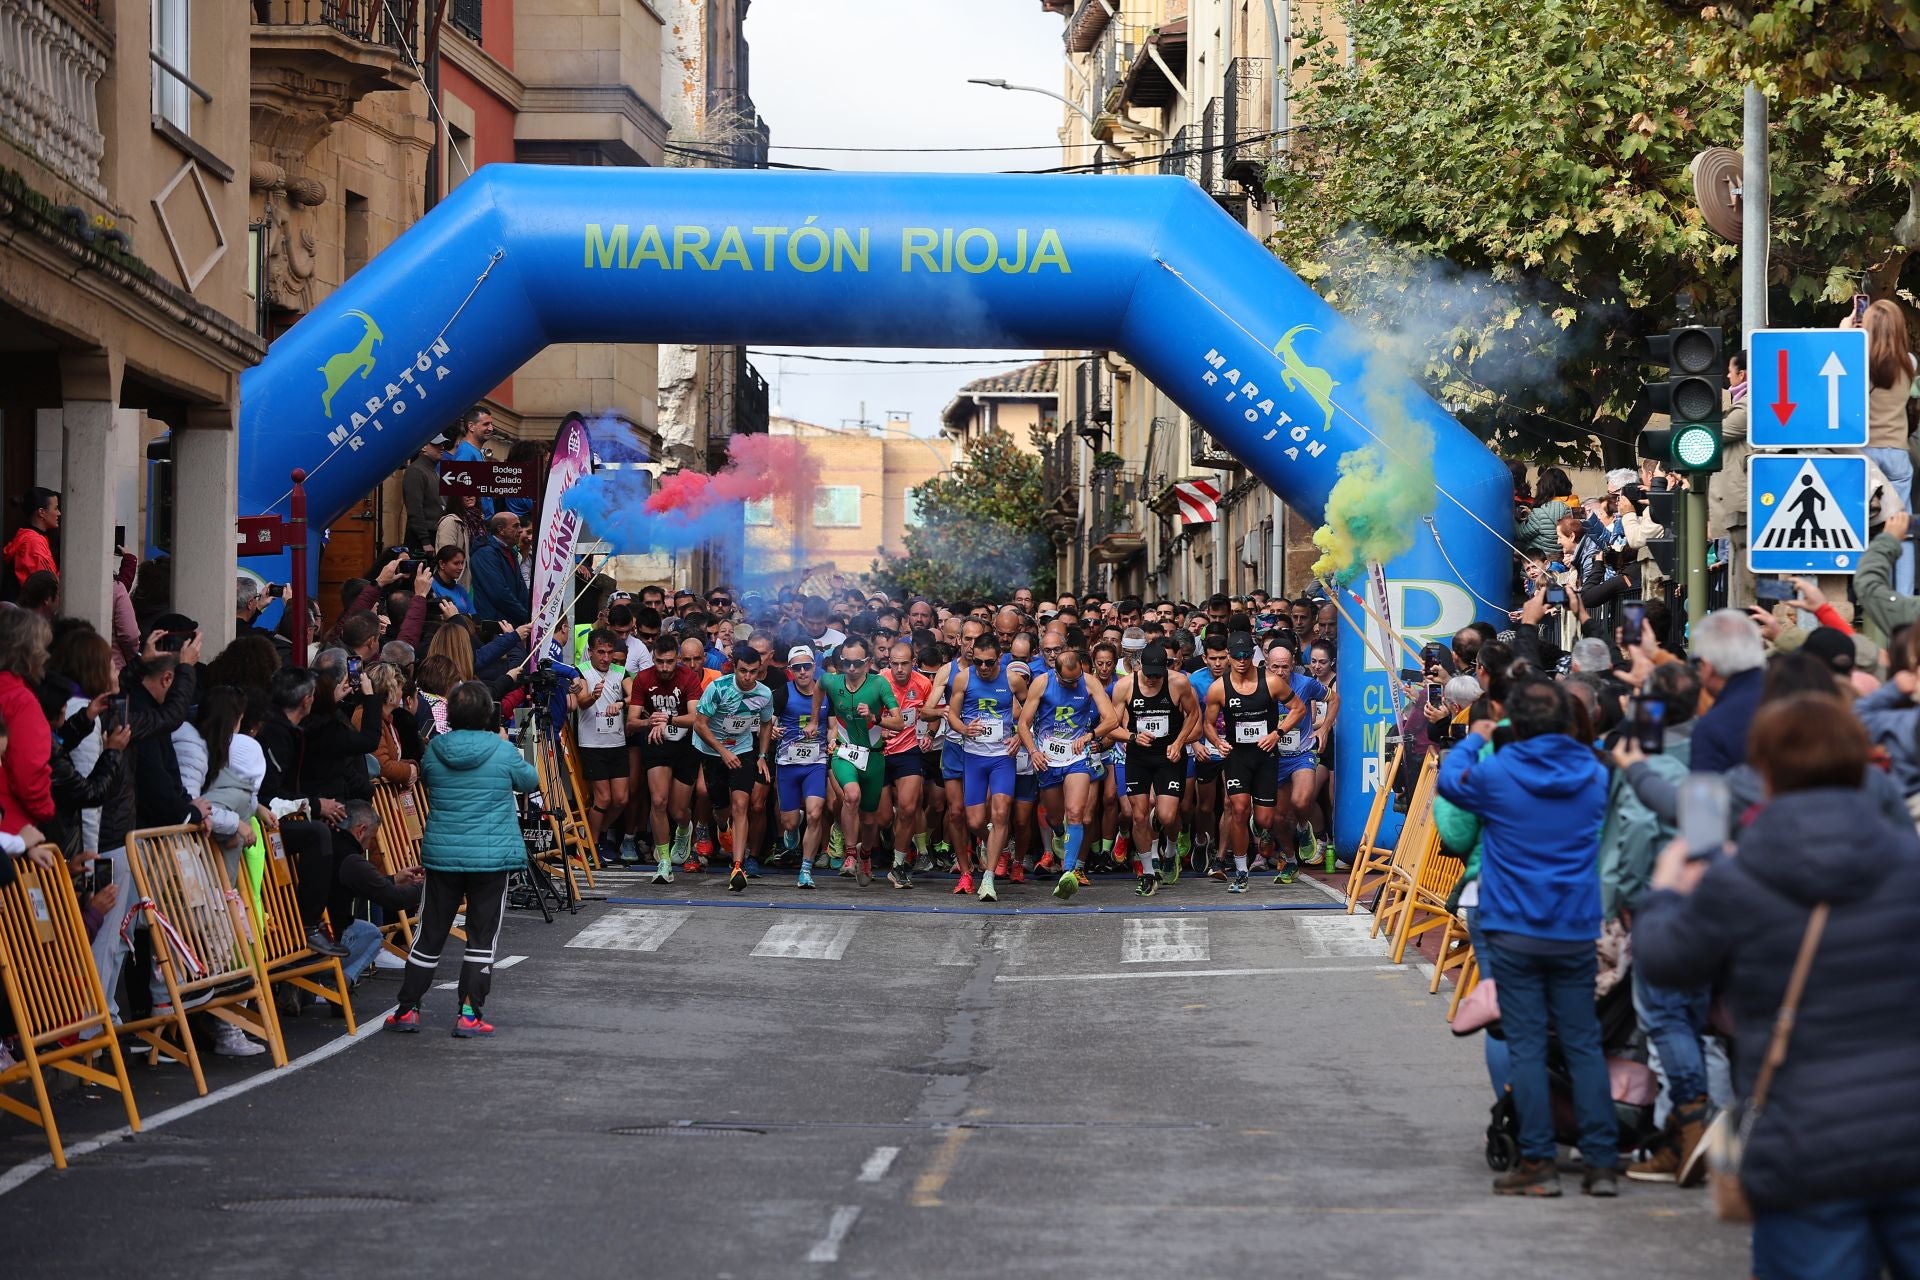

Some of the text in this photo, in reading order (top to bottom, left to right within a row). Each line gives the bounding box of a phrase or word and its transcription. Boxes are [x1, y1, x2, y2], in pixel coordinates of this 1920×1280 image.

[584, 216, 1072, 274] MARATÓN RIOJA
[327, 337, 451, 447] MARATÓN
[1203, 348, 1327, 458] MARATÓN
[348, 365, 451, 452] RIOJA
[1201, 370, 1300, 462] RIOJA
[492, 465, 522, 475] Bodega
[495, 476, 522, 484] Calado
[1364, 579, 1476, 672] R
[606, 717, 614, 726] 18
[732, 720, 746, 728] 162
[1145, 722, 1160, 731] 491
[1243, 727, 1260, 736] 694
[1279, 736, 1293, 745] 09
[796, 748, 812, 757] 252
[1049, 742, 1066, 754] 666
[847, 751, 859, 760] 40
